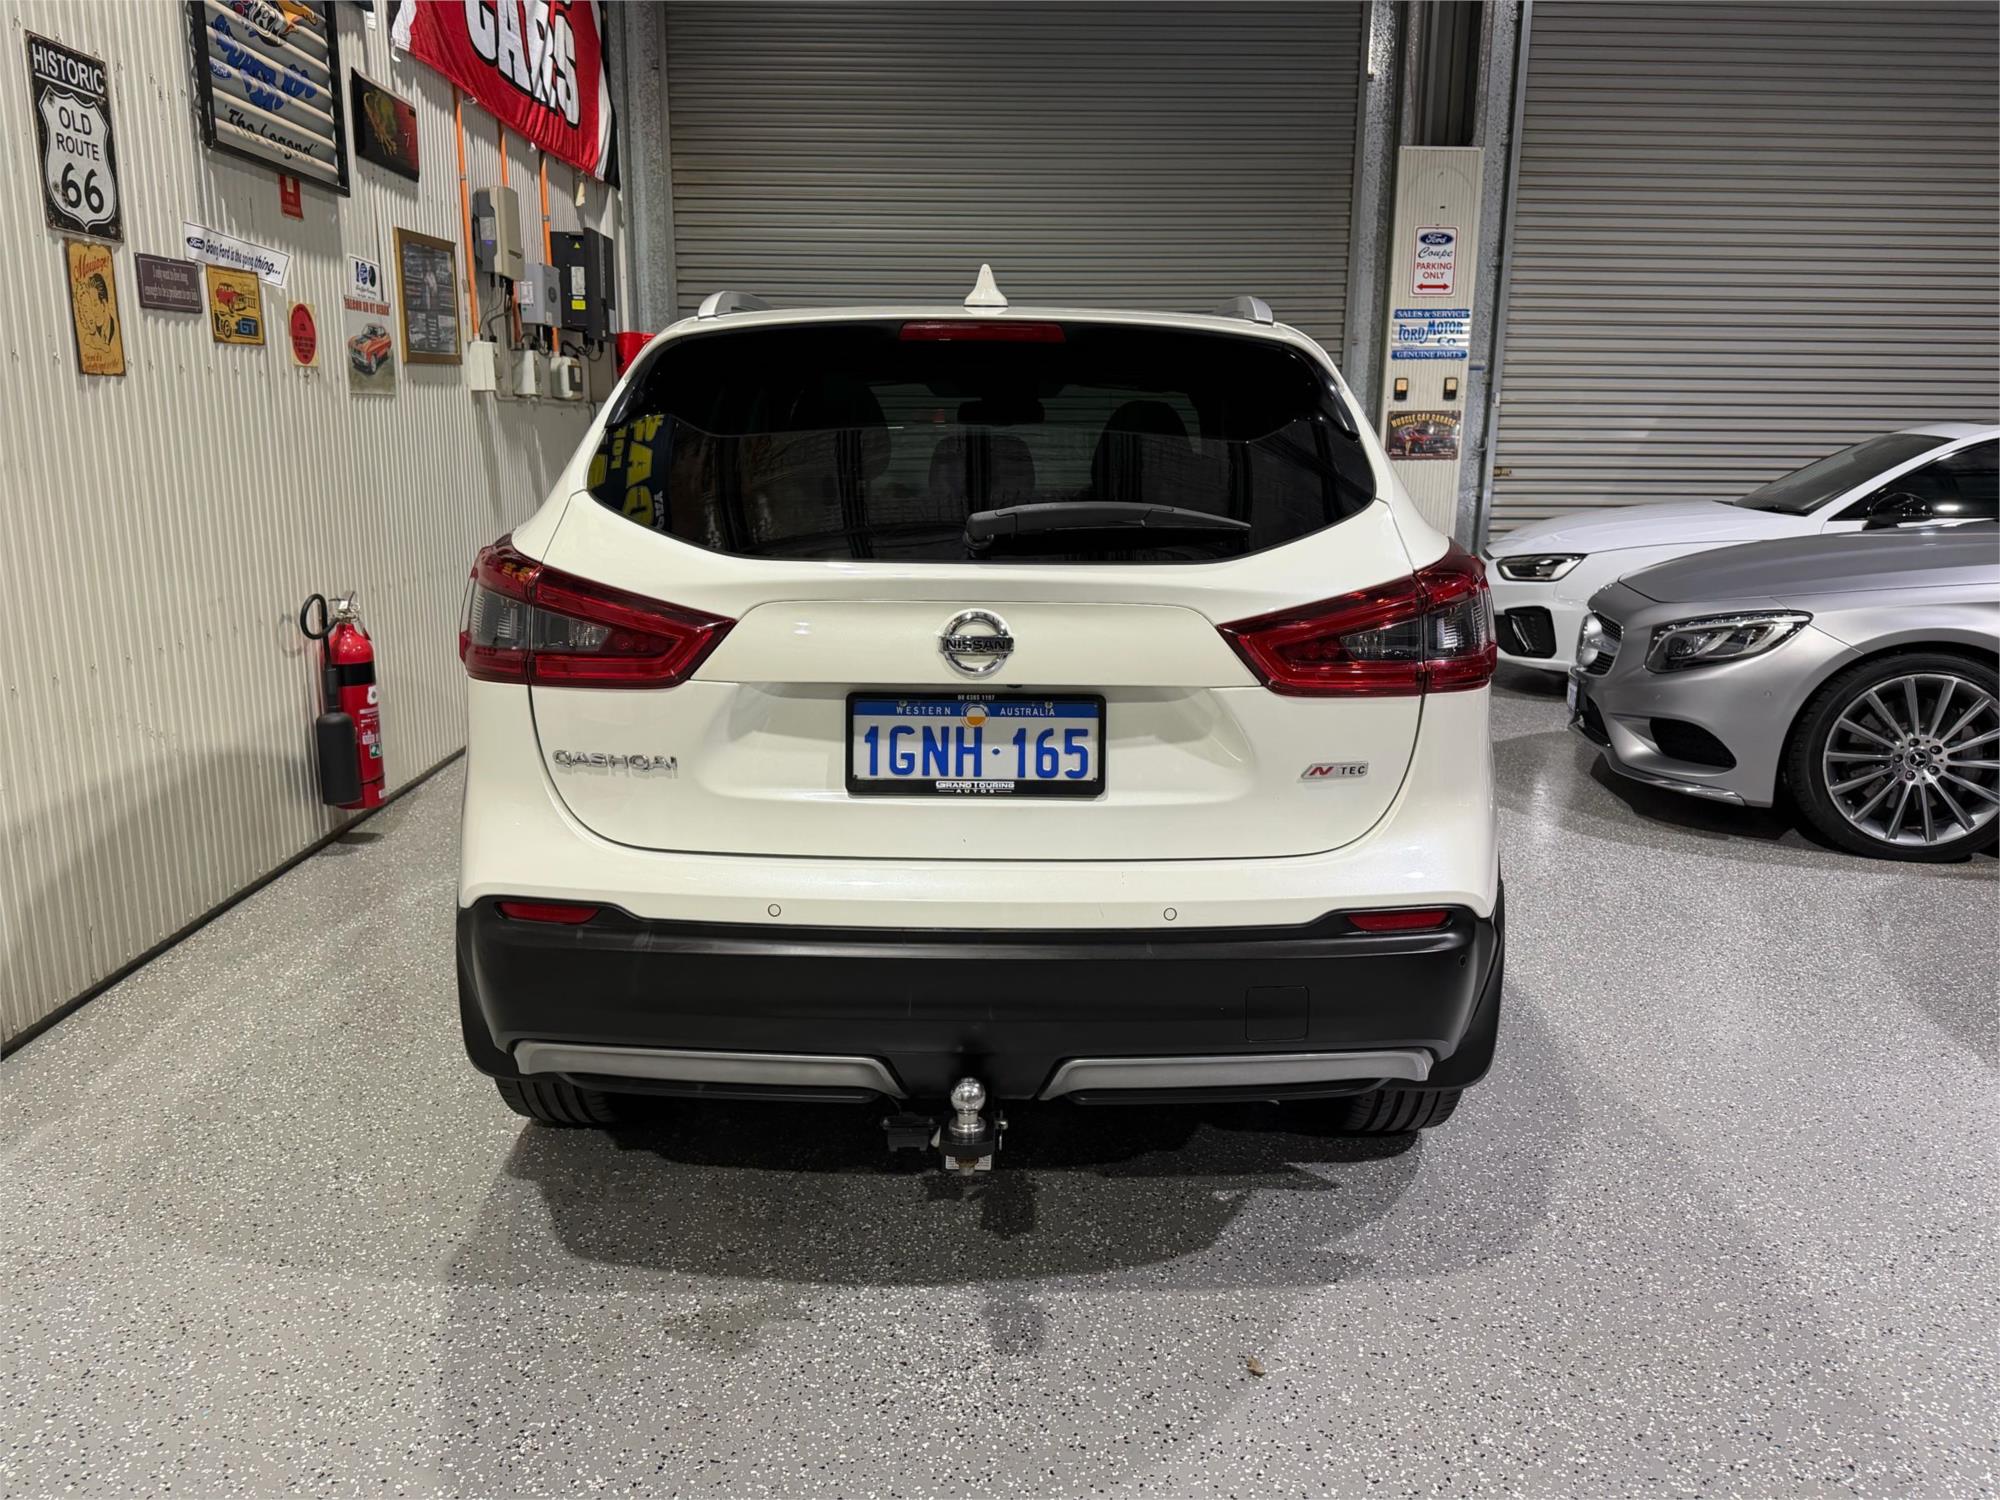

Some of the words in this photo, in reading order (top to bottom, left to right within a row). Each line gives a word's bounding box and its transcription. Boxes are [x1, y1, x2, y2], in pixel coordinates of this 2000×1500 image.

[32, 43, 105, 95] HISTORIC
[464, 0, 581, 128] CARS
[58, 106, 92, 136] OLD
[55, 132, 101, 161] ROUTE
[61, 162, 105, 215] 66
[188, 237, 205, 249] Ford
[1425, 233, 1448, 244] Ford
[1418, 246, 1453, 259] Coupe
[1416, 262, 1452, 270] PARKING
[1422, 271, 1445, 280] ONLY
[1396, 310, 1423, 318] SALES
[1424, 310, 1431, 318] &
[1432, 310, 1468, 318] SERVICE
[1399, 323, 1428, 344] FORD
[1428, 320, 1464, 336] MOTOR
[1391, 414, 1416, 427] MUSCLE
[1417, 413, 1431, 422] CAR
[945, 638, 1006, 651] NISSAN
[895, 705, 951, 716] WESTERN
[1000, 706, 1056, 717] AUSTRALIA
[552, 749, 678, 772] QASHQAI
[1341, 765, 1366, 775] TEC
[936, 781, 972, 789] GRAND
[972, 781, 1015, 789] TOURING
